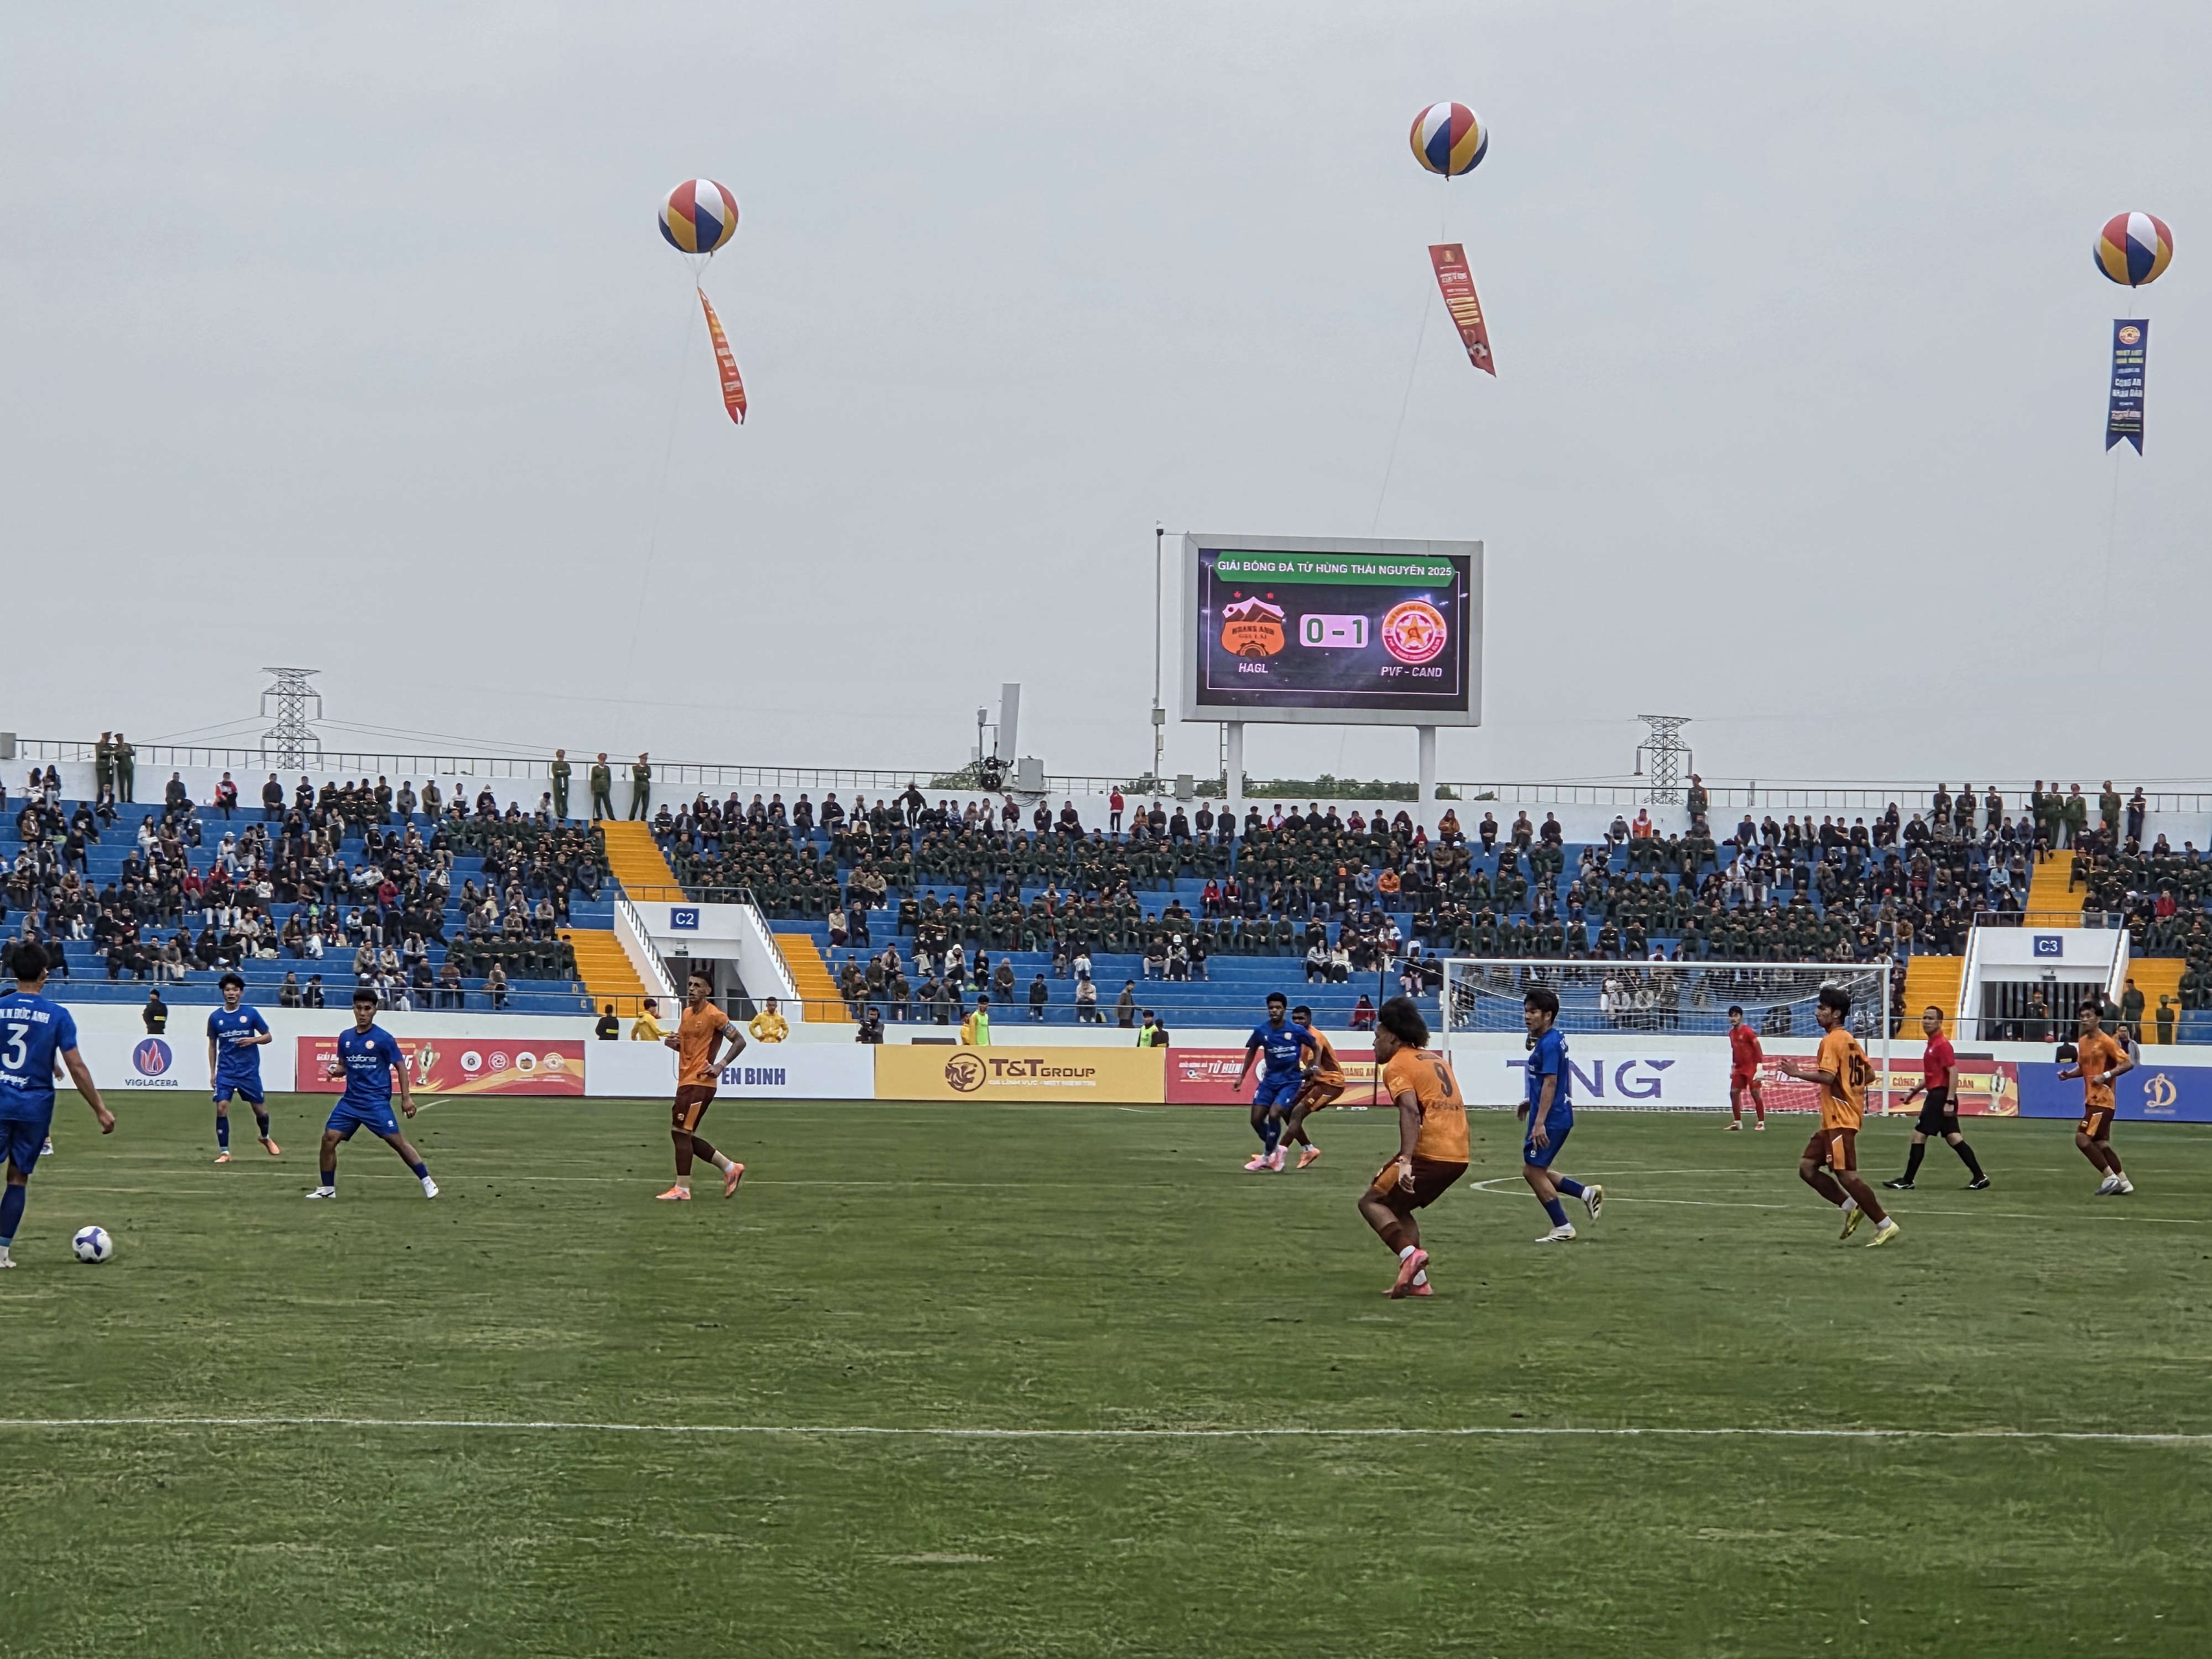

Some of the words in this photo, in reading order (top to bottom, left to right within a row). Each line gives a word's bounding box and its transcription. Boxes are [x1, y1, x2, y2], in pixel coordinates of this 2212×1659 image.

[1218, 560, 1240, 570] GIẢI
[1244, 560, 1275, 571] BÓNG
[1279, 561, 1295, 572] ĐÁ
[1297, 561, 1313, 572] TỨ
[1316, 562, 1347, 573] HÙNG
[1351, 562, 1375, 574] THÁI
[1379, 564, 1425, 575] NGUYÊN
[1428, 567, 1452, 576] 2025
[1307, 618, 1323, 643] 0
[1353, 619, 1362, 644] 1
[1238, 663, 1268, 673] HAGL
[1381, 666, 1403, 676] PVF
[1412, 667, 1442, 677] CAND
[676, 912, 694, 925] C2
[2039, 940, 2058, 952] C3
[2, 1023, 29, 1070] 3
[989, 1058, 1044, 1077] T&T
[1041, 1068, 1095, 1077] GROUP
[745, 1068, 785, 1085] BINH
[1433, 1062, 1453, 1098] 9
